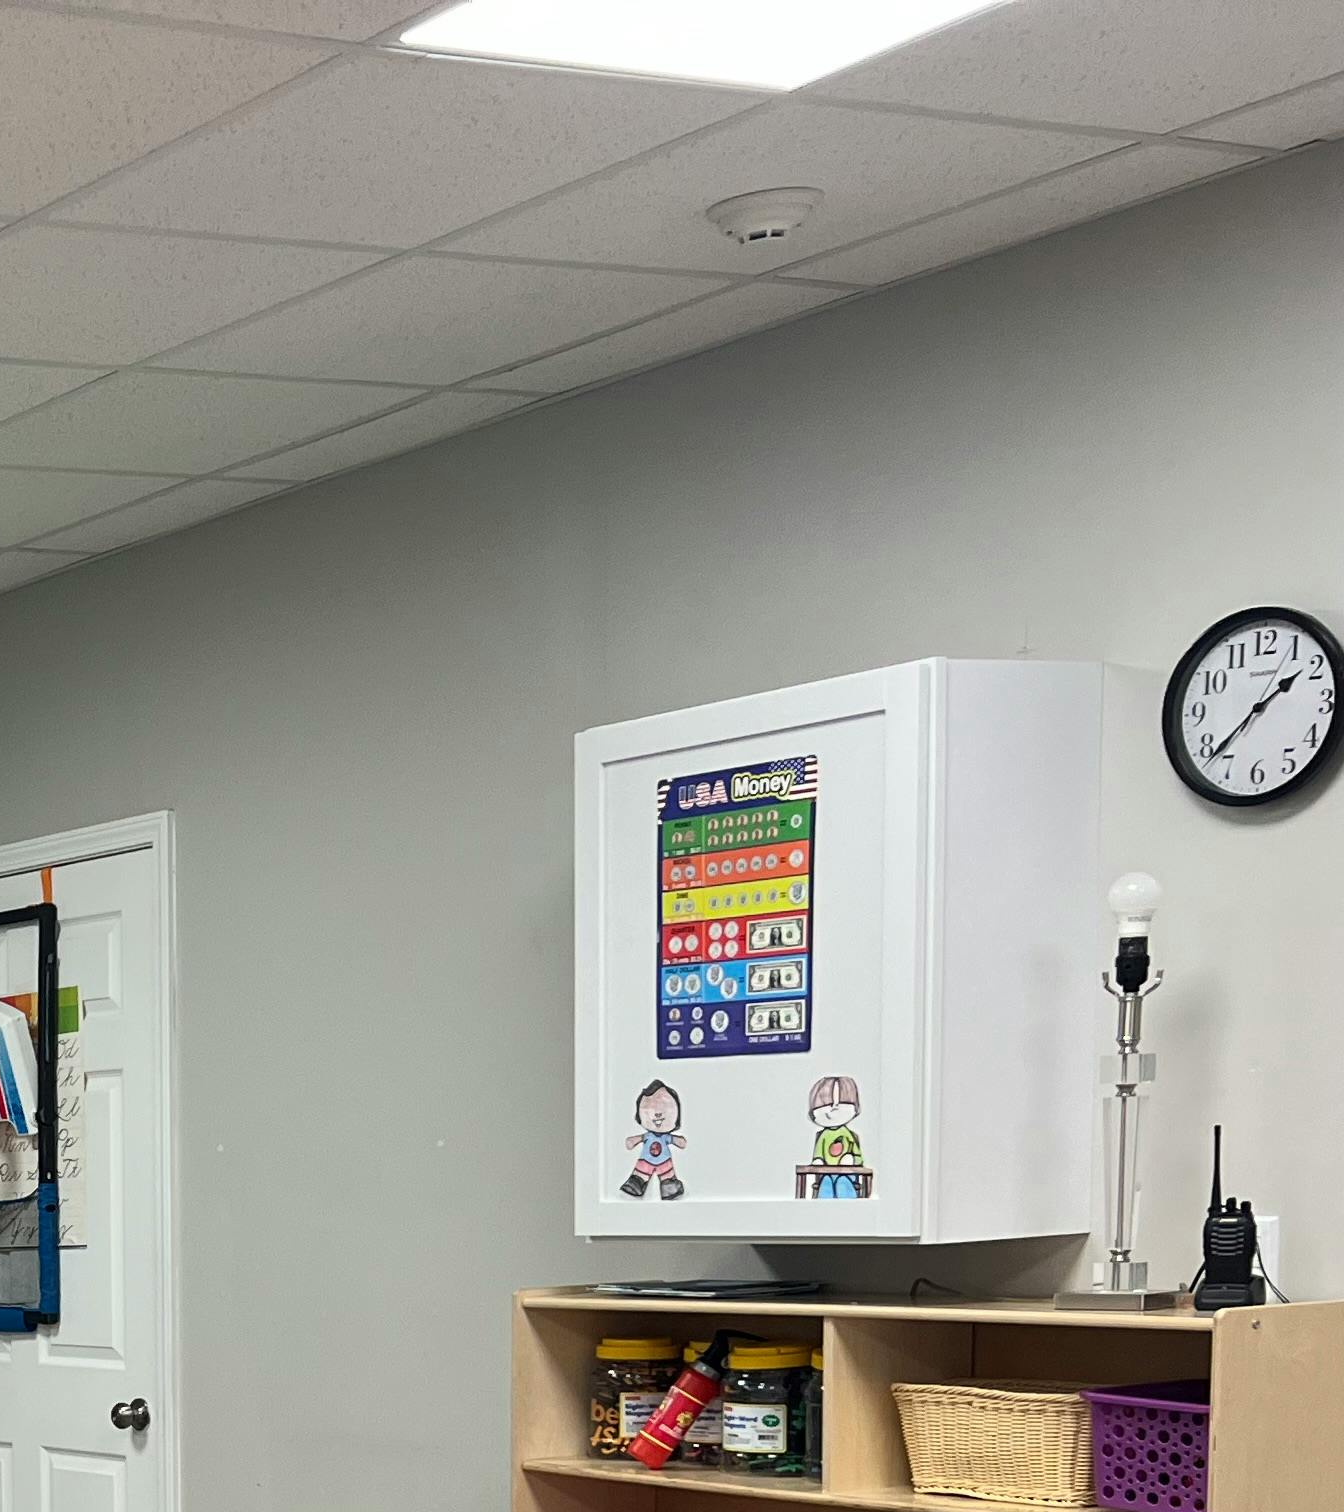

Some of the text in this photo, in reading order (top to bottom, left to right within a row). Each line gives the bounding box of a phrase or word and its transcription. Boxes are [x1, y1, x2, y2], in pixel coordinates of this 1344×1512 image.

[1253, 629, 1278, 656] 12
[1289, 635, 1299, 661] 1
[1226, 643, 1246, 669] 11
[1308, 654, 1324, 680] 2
[1202, 669, 1227, 695] 10
[1191, 701, 1206, 727] 9
[1318, 688, 1334, 714] 3
[1199, 733, 1214, 758] 8
[1302, 722, 1319, 748] 4
[1222, 754, 1235, 780] 7
[1250, 759, 1265, 784] 6
[1281, 747, 1297, 774] 5
[678, 772, 793, 810] USA Money
